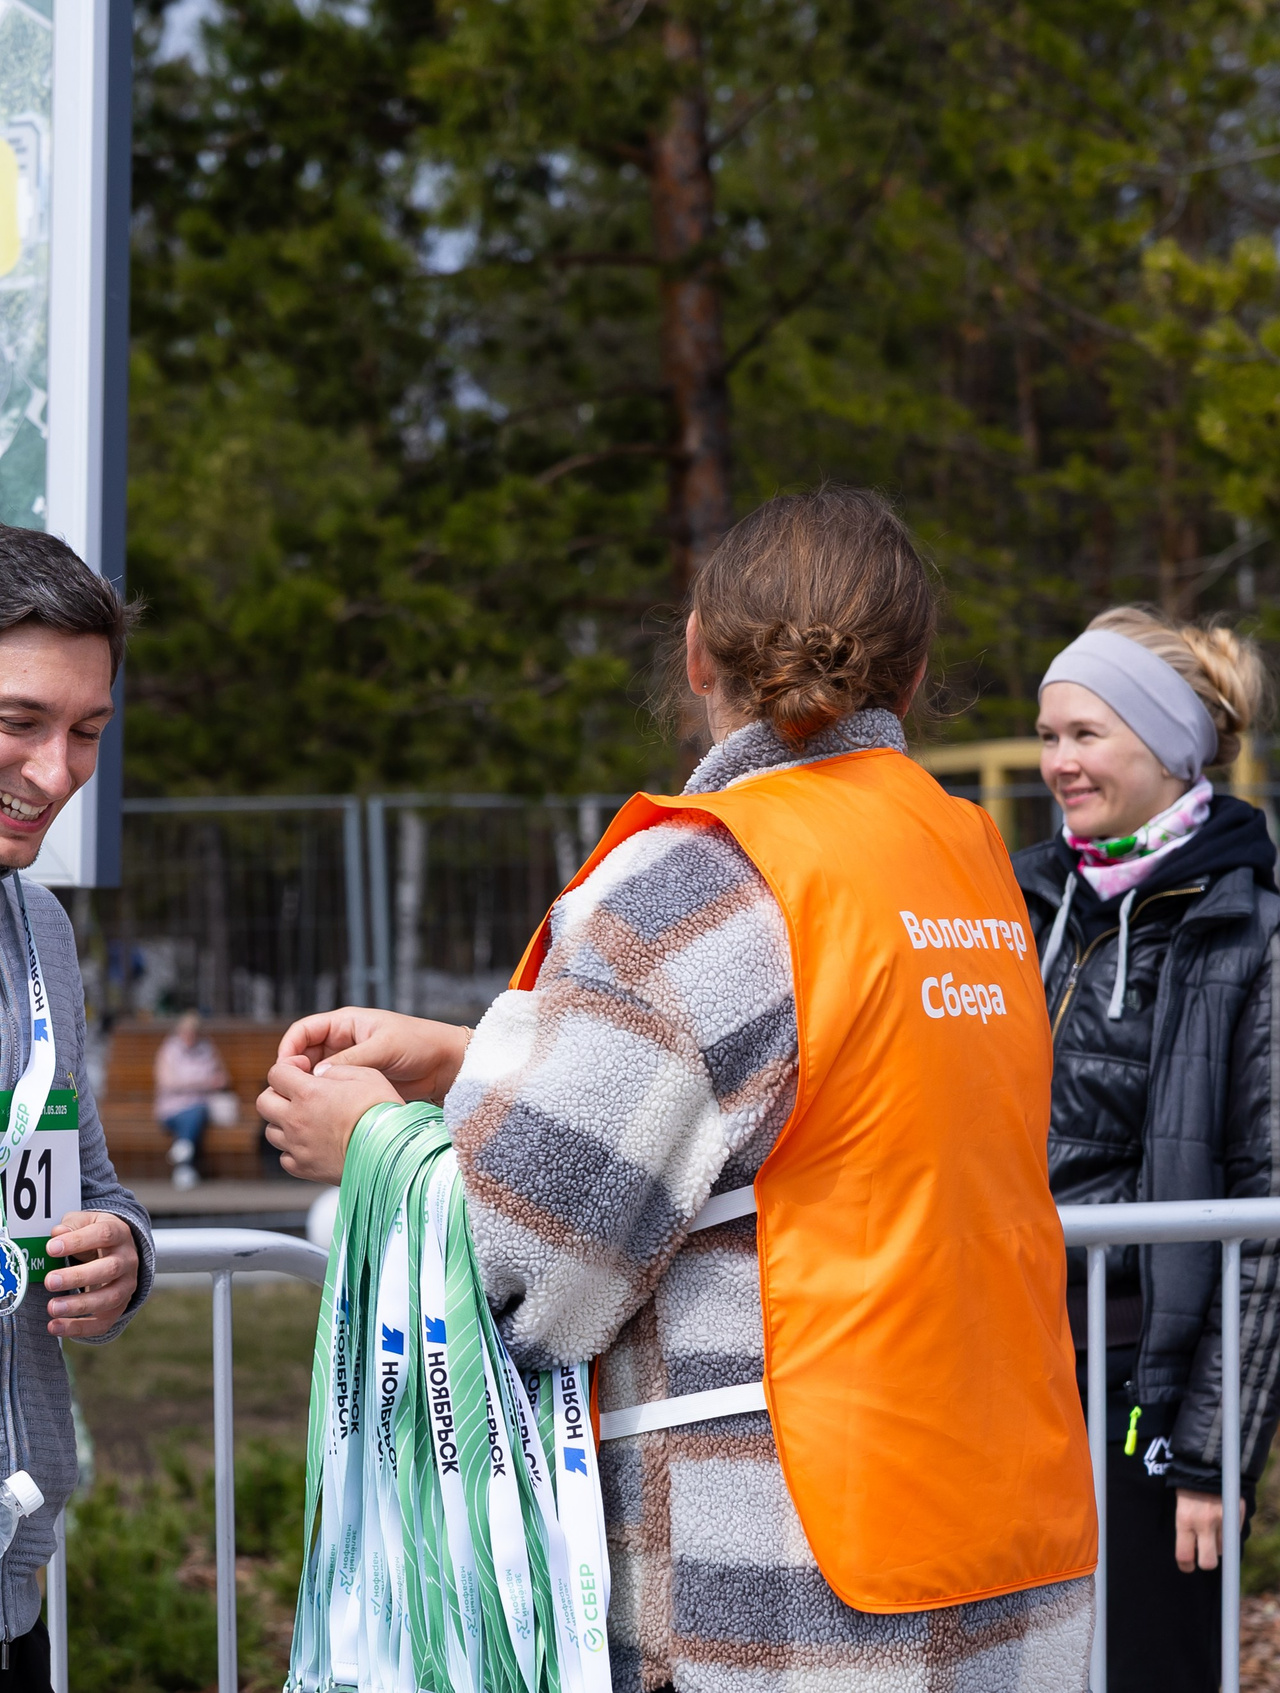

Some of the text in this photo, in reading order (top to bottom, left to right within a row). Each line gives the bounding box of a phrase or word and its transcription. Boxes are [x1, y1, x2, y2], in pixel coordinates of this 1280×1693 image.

[899, 910, 1027, 961] Волонтер
[921, 972, 1007, 1024] Сбера
[11, 1103, 30, 1146] СБЕР
[427, 1351, 460, 1476] НОЯБРЬСК
[343, 1523, 352, 1569] марафон
[372, 1551, 381, 1598] марафон
[460, 1565, 470, 1613] марафон
[466, 1570, 477, 1616] зелёный
[505, 1568, 520, 1615] марафон
[514, 1572, 530, 1618] зелёный
[579, 1563, 599, 1622] СБЕР
